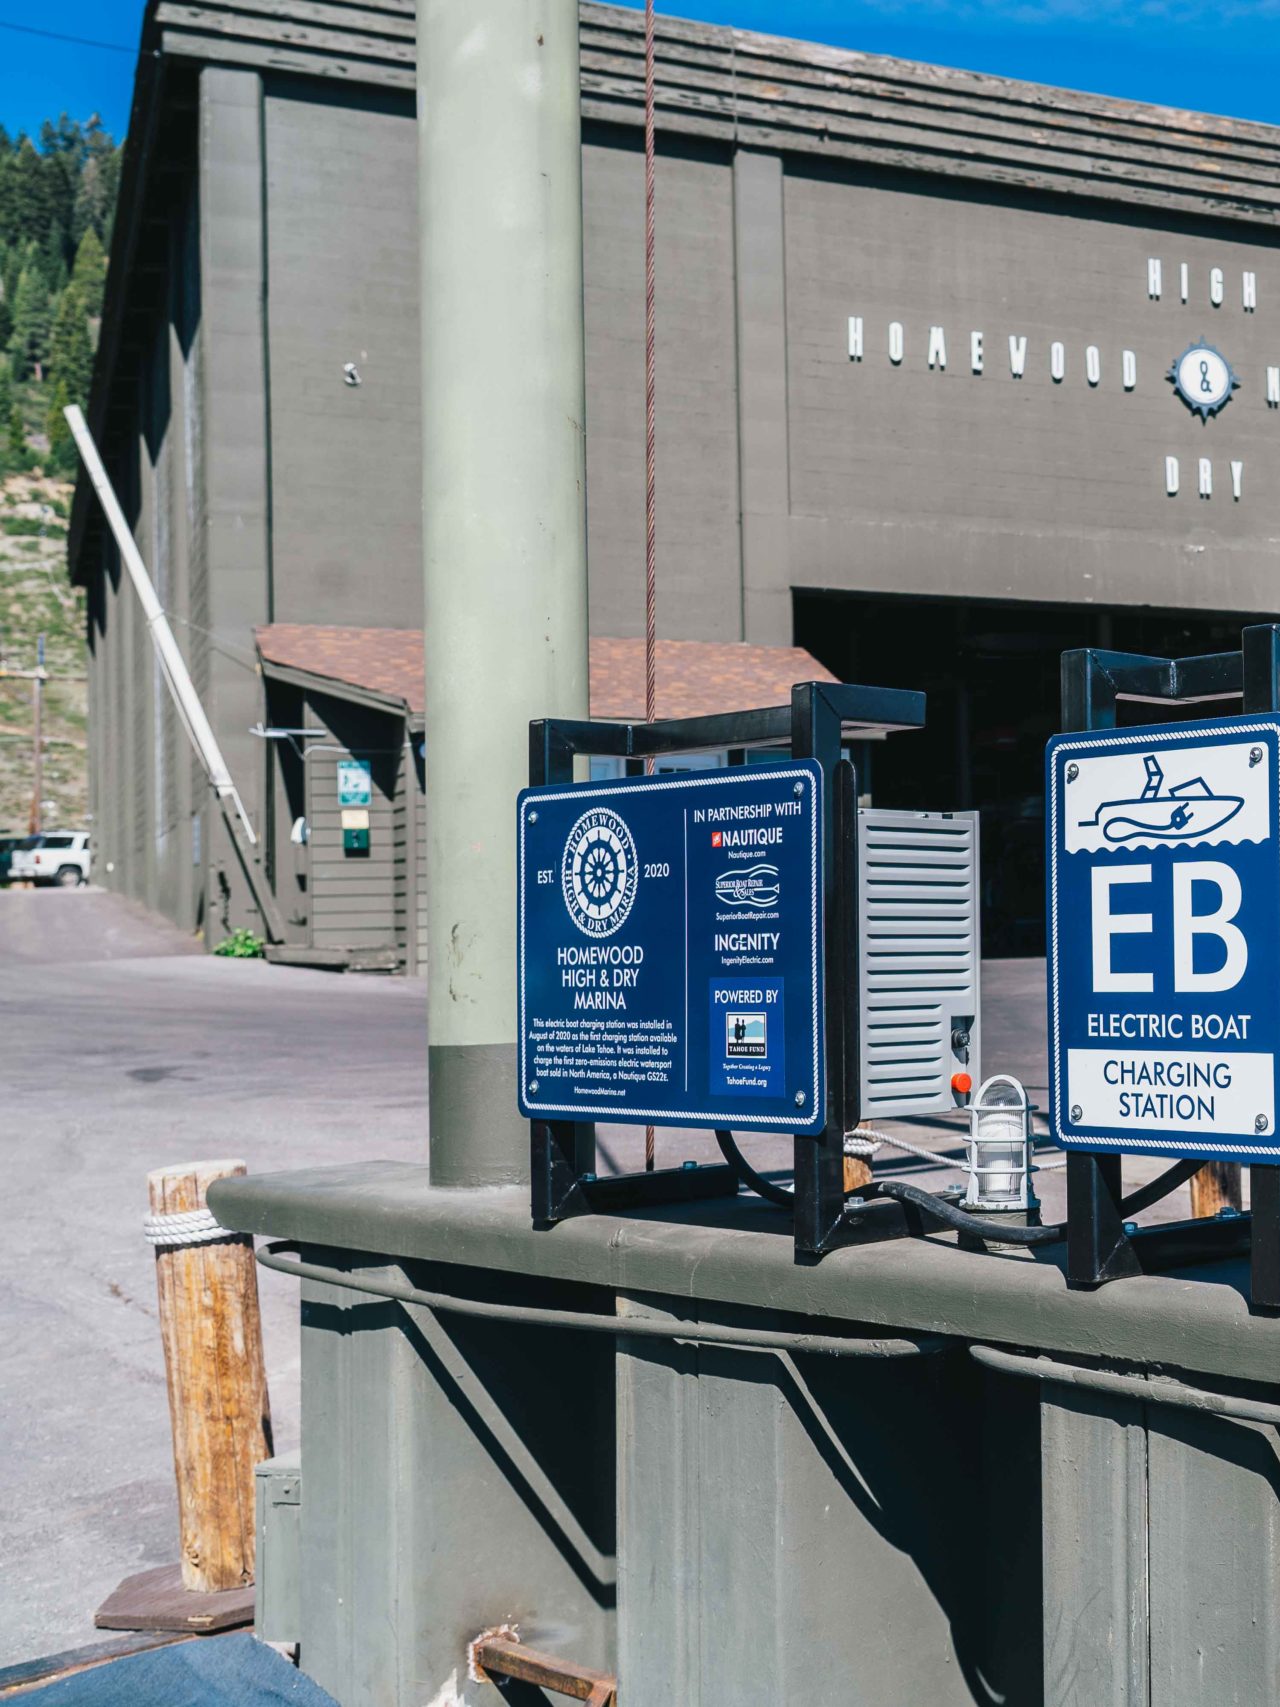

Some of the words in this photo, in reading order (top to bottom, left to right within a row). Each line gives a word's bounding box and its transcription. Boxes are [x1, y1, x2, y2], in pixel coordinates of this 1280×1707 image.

[1148, 258, 1256, 313] HIGH
[848, 316, 1137, 392] HOMEWOOD
[1165, 456, 1244, 502] DRY
[694, 810, 704, 823] IN
[708, 804, 772, 821] PARTNERSHIP
[774, 801, 801, 816] WITH
[569, 814, 630, 854] HOMEWOOD
[722, 827, 783, 847] NAUTIQUE
[728, 850, 766, 859] Nautique.com
[538, 870, 554, 884] EST.
[644, 863, 669, 878] 2020
[588, 919, 608, 931] DRY
[1091, 860, 1248, 993] EB
[715, 933, 780, 951] INGENITY
[558, 946, 644, 965] HOMEWOOD
[562, 969, 596, 987] HIGH
[600, 970, 610, 987] &
[614, 969, 639, 987] DRY
[574, 992, 626, 1009] MARINA
[714, 990, 762, 1003] POWERED
[766, 990, 778, 1003] BY
[533, 1018, 544, 1027] This
[546, 1019, 564, 1028] electric
[566, 1019, 578, 1028] boat
[580, 1019, 605, 1030] charging
[606, 1020, 625, 1029] station
[640, 1020, 664, 1029] installed
[666, 1020, 672, 1029] in
[1087, 1013, 1183, 1038] ELECTRIC
[1192, 1014, 1251, 1040] BOAT
[529, 1031, 548, 1041] August
[549, 1031, 555, 1039] of
[556, 1032, 570, 1040] 2020
[580, 1032, 589, 1041] the
[590, 1032, 601, 1041] first
[602, 1033, 627, 1043] charging
[629, 1033, 648, 1042] station
[650, 1033, 677, 1043] available
[546, 1043, 554, 1052] the
[556, 1044, 574, 1053] waters
[575, 1044, 582, 1053] of
[582, 1044, 595, 1053] Lake
[597, 1045, 615, 1054] Tahoe.
[617, 1045, 621, 1054] It
[636, 1046, 660, 1055] installed
[662, 1047, 668, 1055] to
[534, 1056, 552, 1066] charge
[554, 1056, 562, 1064] the
[564, 1056, 574, 1065] first
[575, 1058, 617, 1066] zero-emissions
[618, 1058, 639, 1067] electric
[640, 1059, 672, 1070] watersport
[536, 1068, 549, 1077] boat
[550, 1068, 561, 1077] sold
[562, 1068, 568, 1077] in
[569, 1069, 585, 1078] North
[586, 1070, 612, 1080] America,
[619, 1071, 645, 1083] Nautique
[727, 1077, 767, 1087] TahoeFund.org
[1103, 1060, 1232, 1089] CHARGING
[574, 1086, 625, 1096] HomewoodMarina.net
[1119, 1093, 1215, 1121] STATION
